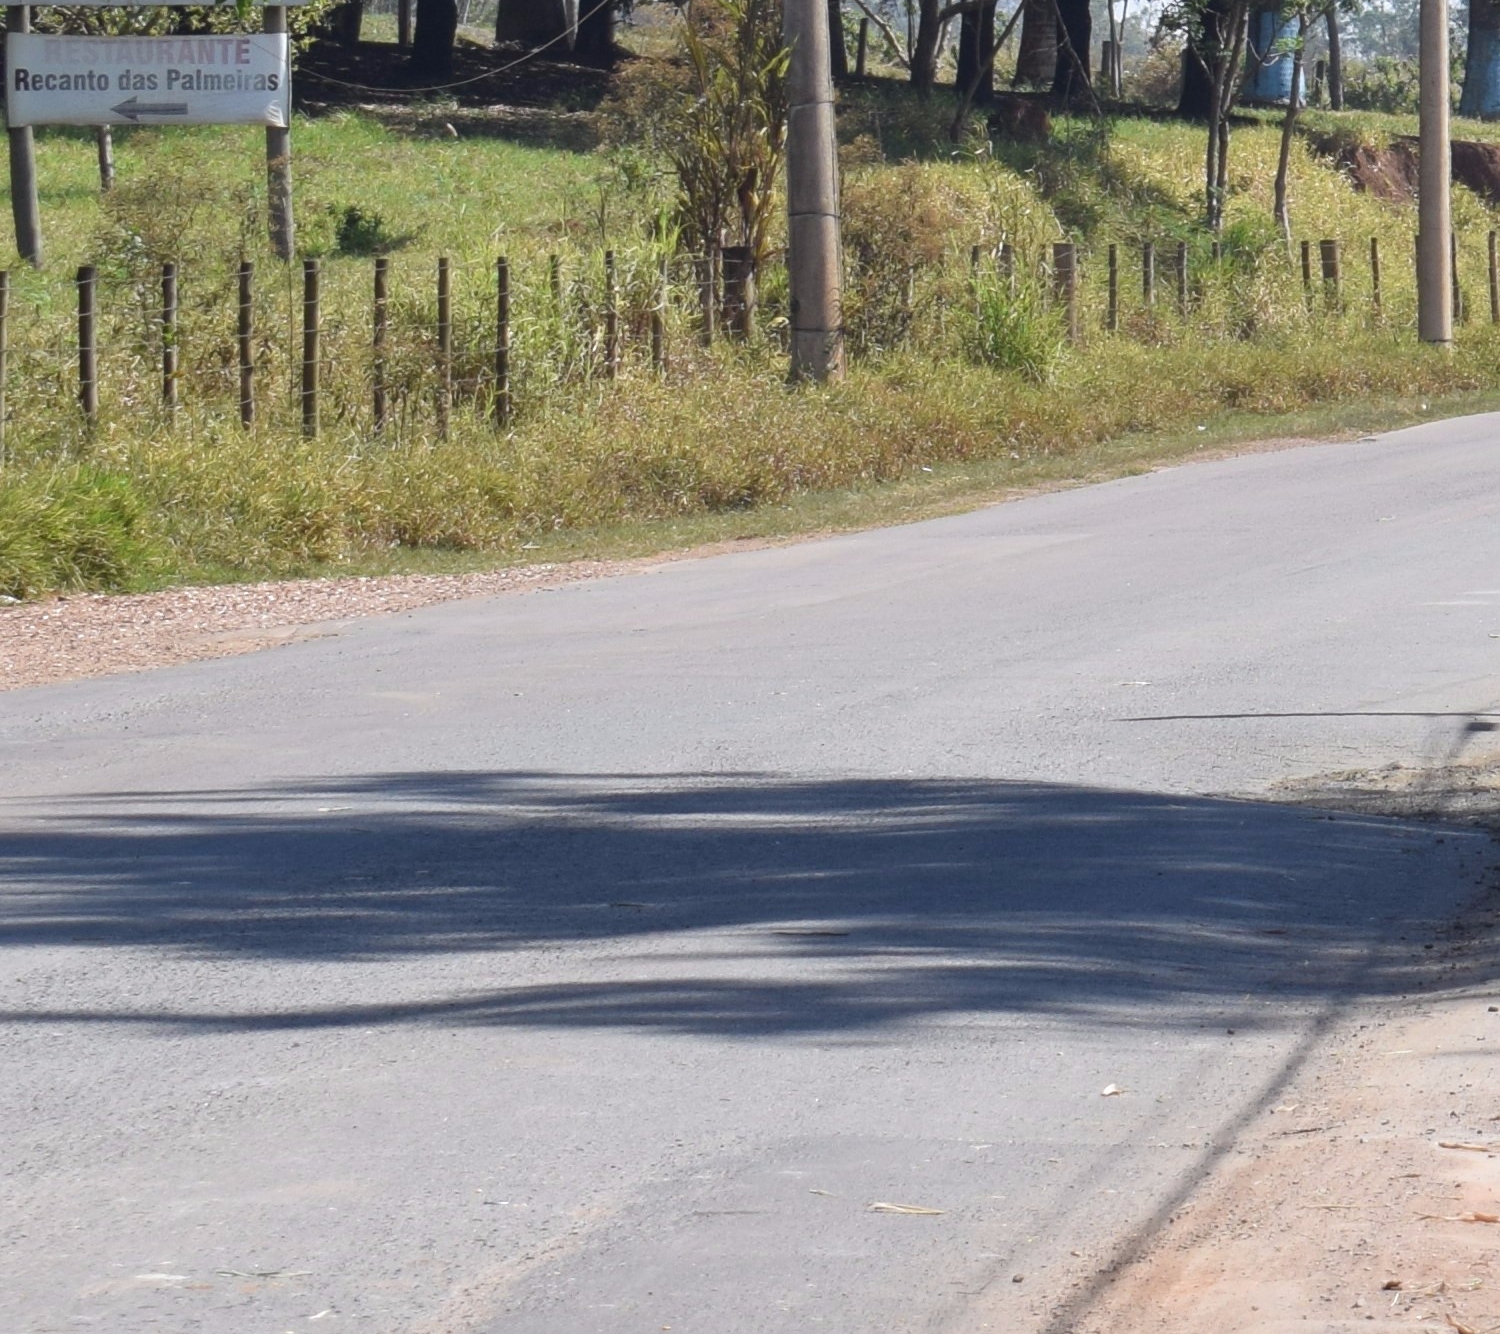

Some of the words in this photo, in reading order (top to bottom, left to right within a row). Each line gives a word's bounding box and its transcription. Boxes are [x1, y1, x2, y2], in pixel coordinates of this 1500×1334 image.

[45, 39, 251, 65] RESTAURANTE
[14, 68, 110, 92] Recanto
[118, 68, 158, 91] das
[167, 68, 280, 92] Palmeiras
